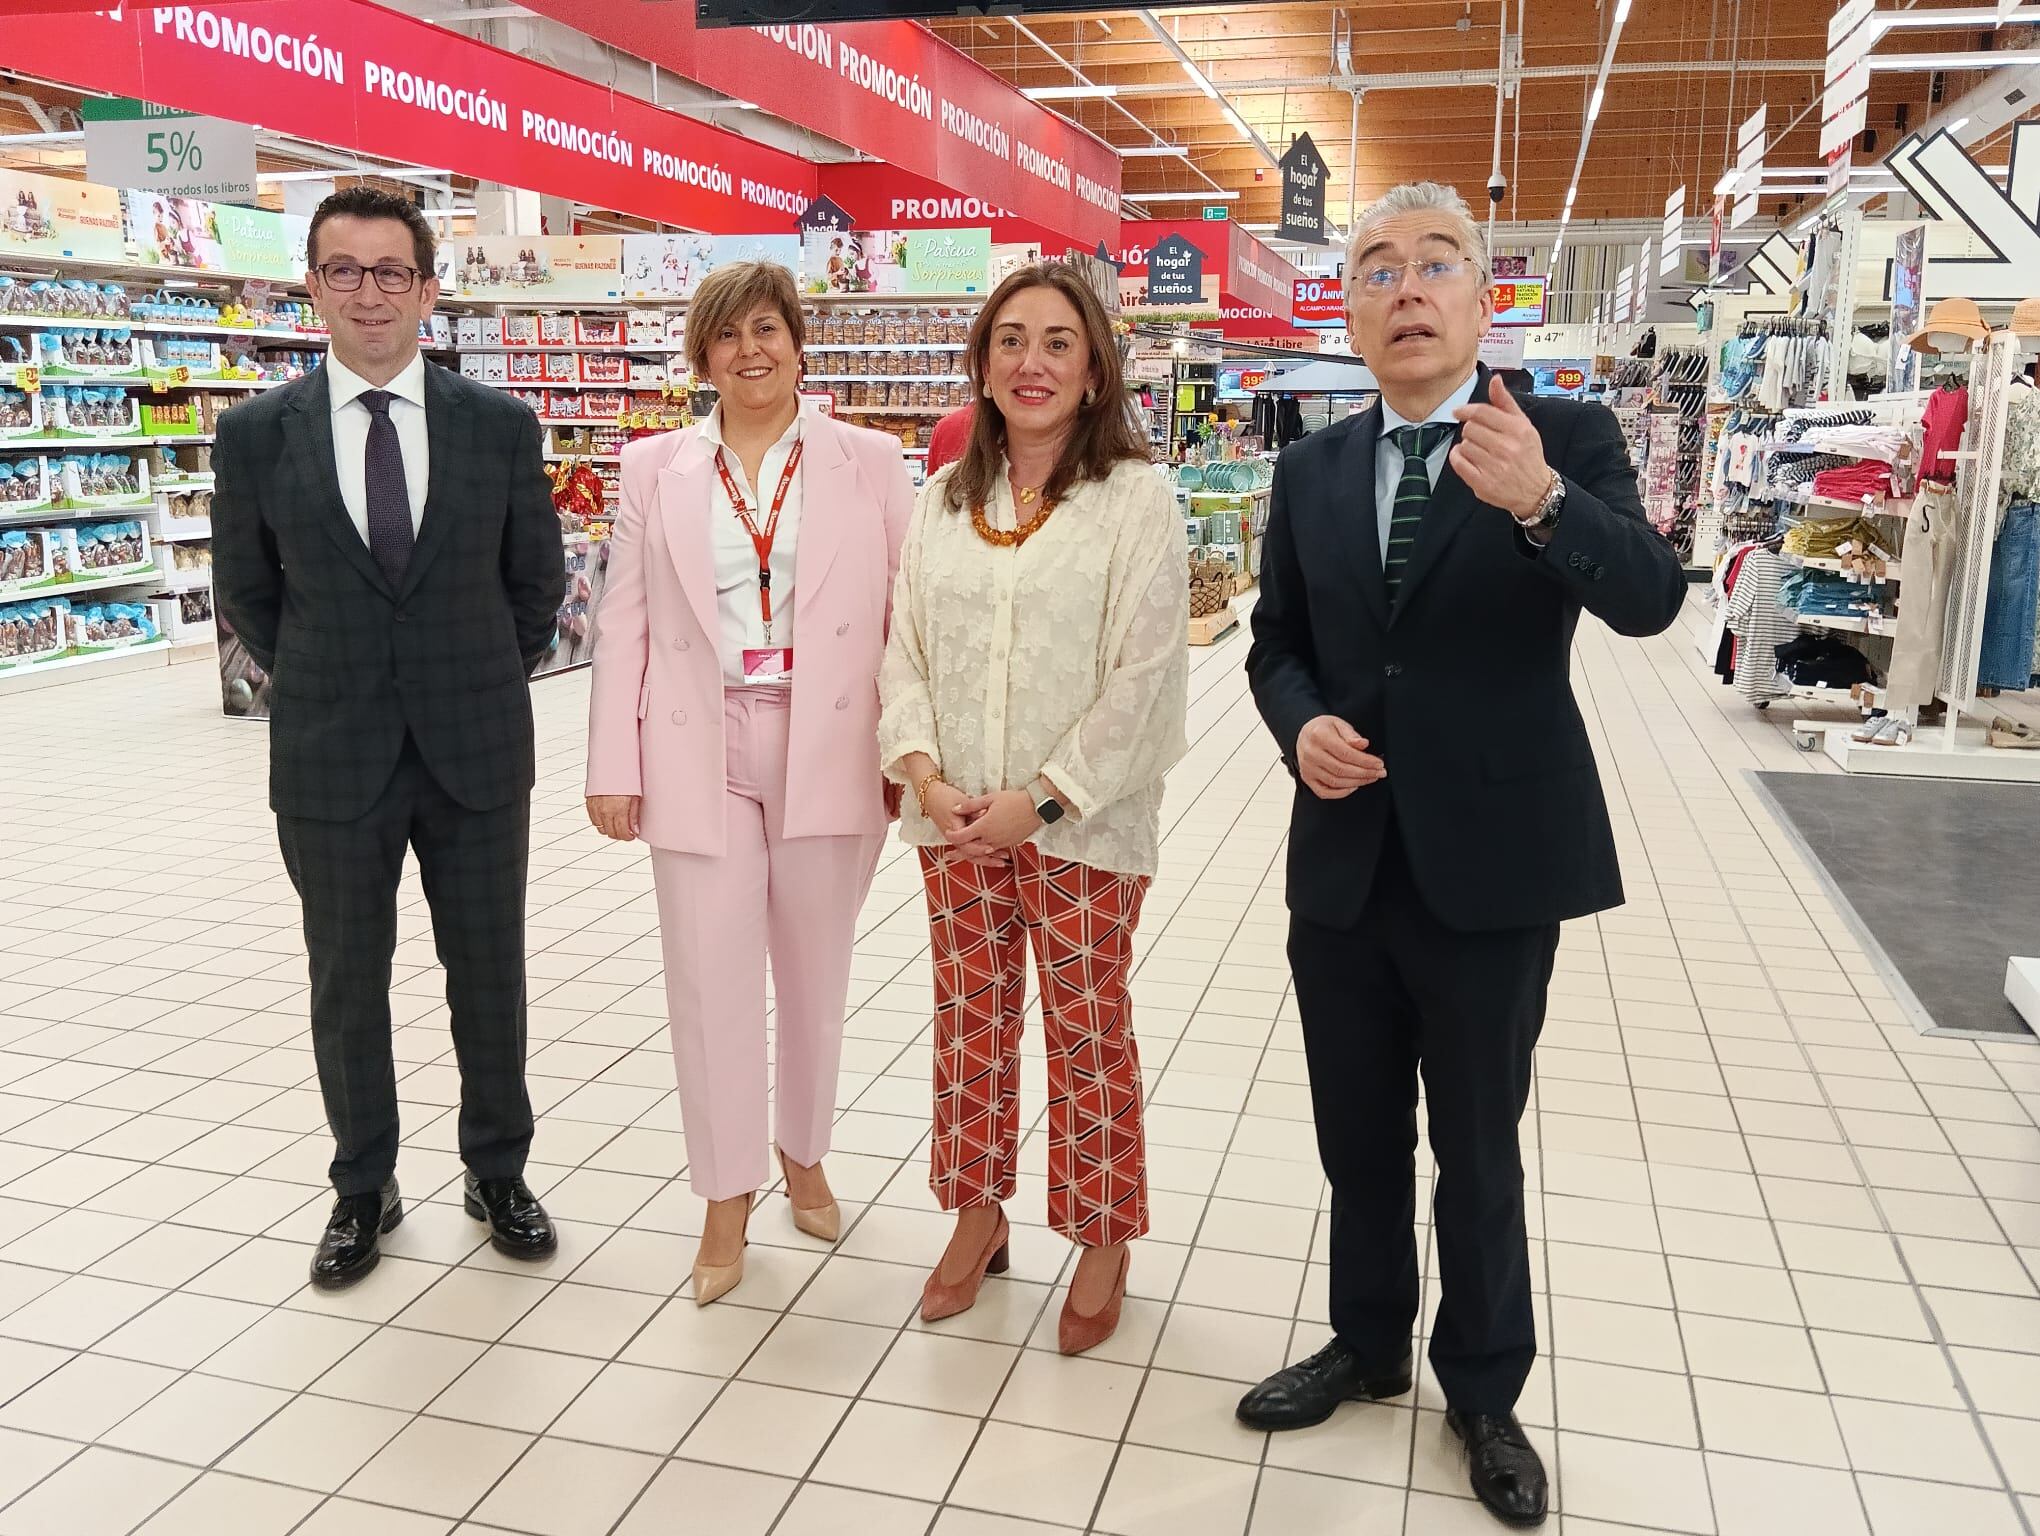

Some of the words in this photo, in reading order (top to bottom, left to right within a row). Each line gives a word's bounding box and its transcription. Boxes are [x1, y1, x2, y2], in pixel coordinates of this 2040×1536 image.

[153, 6, 344, 84] PROMOCIÓN
[364, 60, 508, 131] PROMOCIÓN
[522, 109, 633, 167] PROMOCIÓN
[643, 147, 732, 195] PROMOCIÓN
[839, 41, 933, 121] PROMOCIÓN
[941, 98, 1010, 161] PROMOCIÓN
[1017, 140, 1071, 192] PROMOCIÓN
[1075, 173, 1120, 215] PROMOCIÓN
[147, 130, 202, 173] 5%
[1301, 154, 1308, 166] El
[1290, 166, 1318, 189] hogar
[173, 184, 201, 195] todos
[204, 183, 218, 194] los
[221, 182, 250, 193] libros
[1293, 193, 1301, 205] de
[1302, 194, 1313, 207] tus
[890, 198, 1019, 219] PROMOC
[817, 210, 826, 221] El
[1286, 211, 1319, 229] sueños
[924, 237, 978, 258] Pascua
[1169, 246, 1177, 255] El
[1156, 254, 1191, 270] hogar
[911, 260, 985, 291] Sorpresas
[1161, 271, 1171, 281] de
[1172, 272, 1185, 281] tus
[1152, 282, 1193, 295] sueños
[1276, 339, 1303, 349] Libre
[1334, 336, 1341, 344] a
[1534, 333, 1541, 343] a
[1558, 373, 1581, 382] 399
